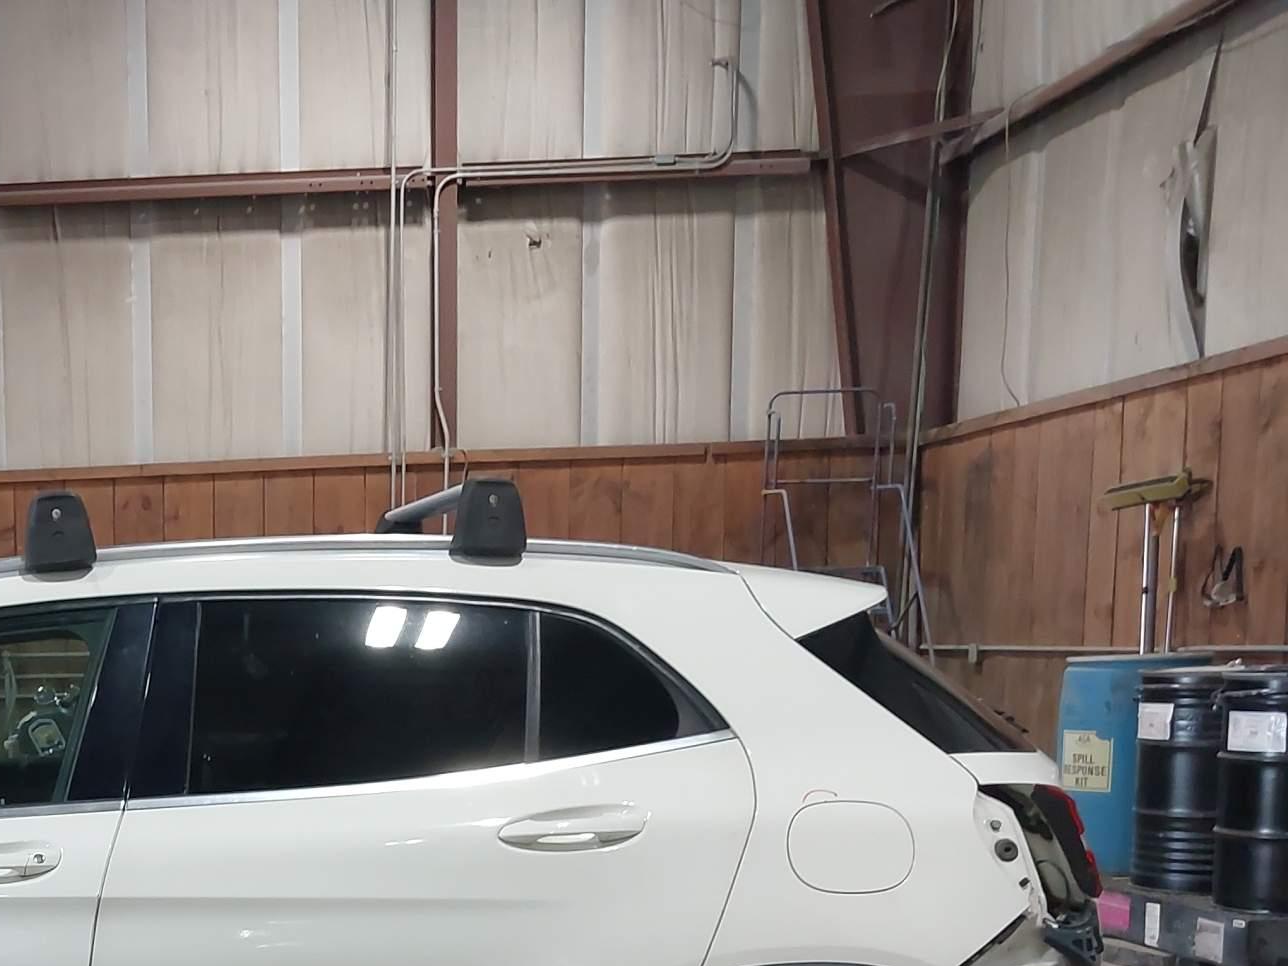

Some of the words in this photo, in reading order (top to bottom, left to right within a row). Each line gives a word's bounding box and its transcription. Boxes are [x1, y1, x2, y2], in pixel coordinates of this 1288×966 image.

[1072, 753, 1095, 764] SPILL
[1063, 764, 1107, 777] RESPONSE
[1074, 777, 1088, 787] KIT
